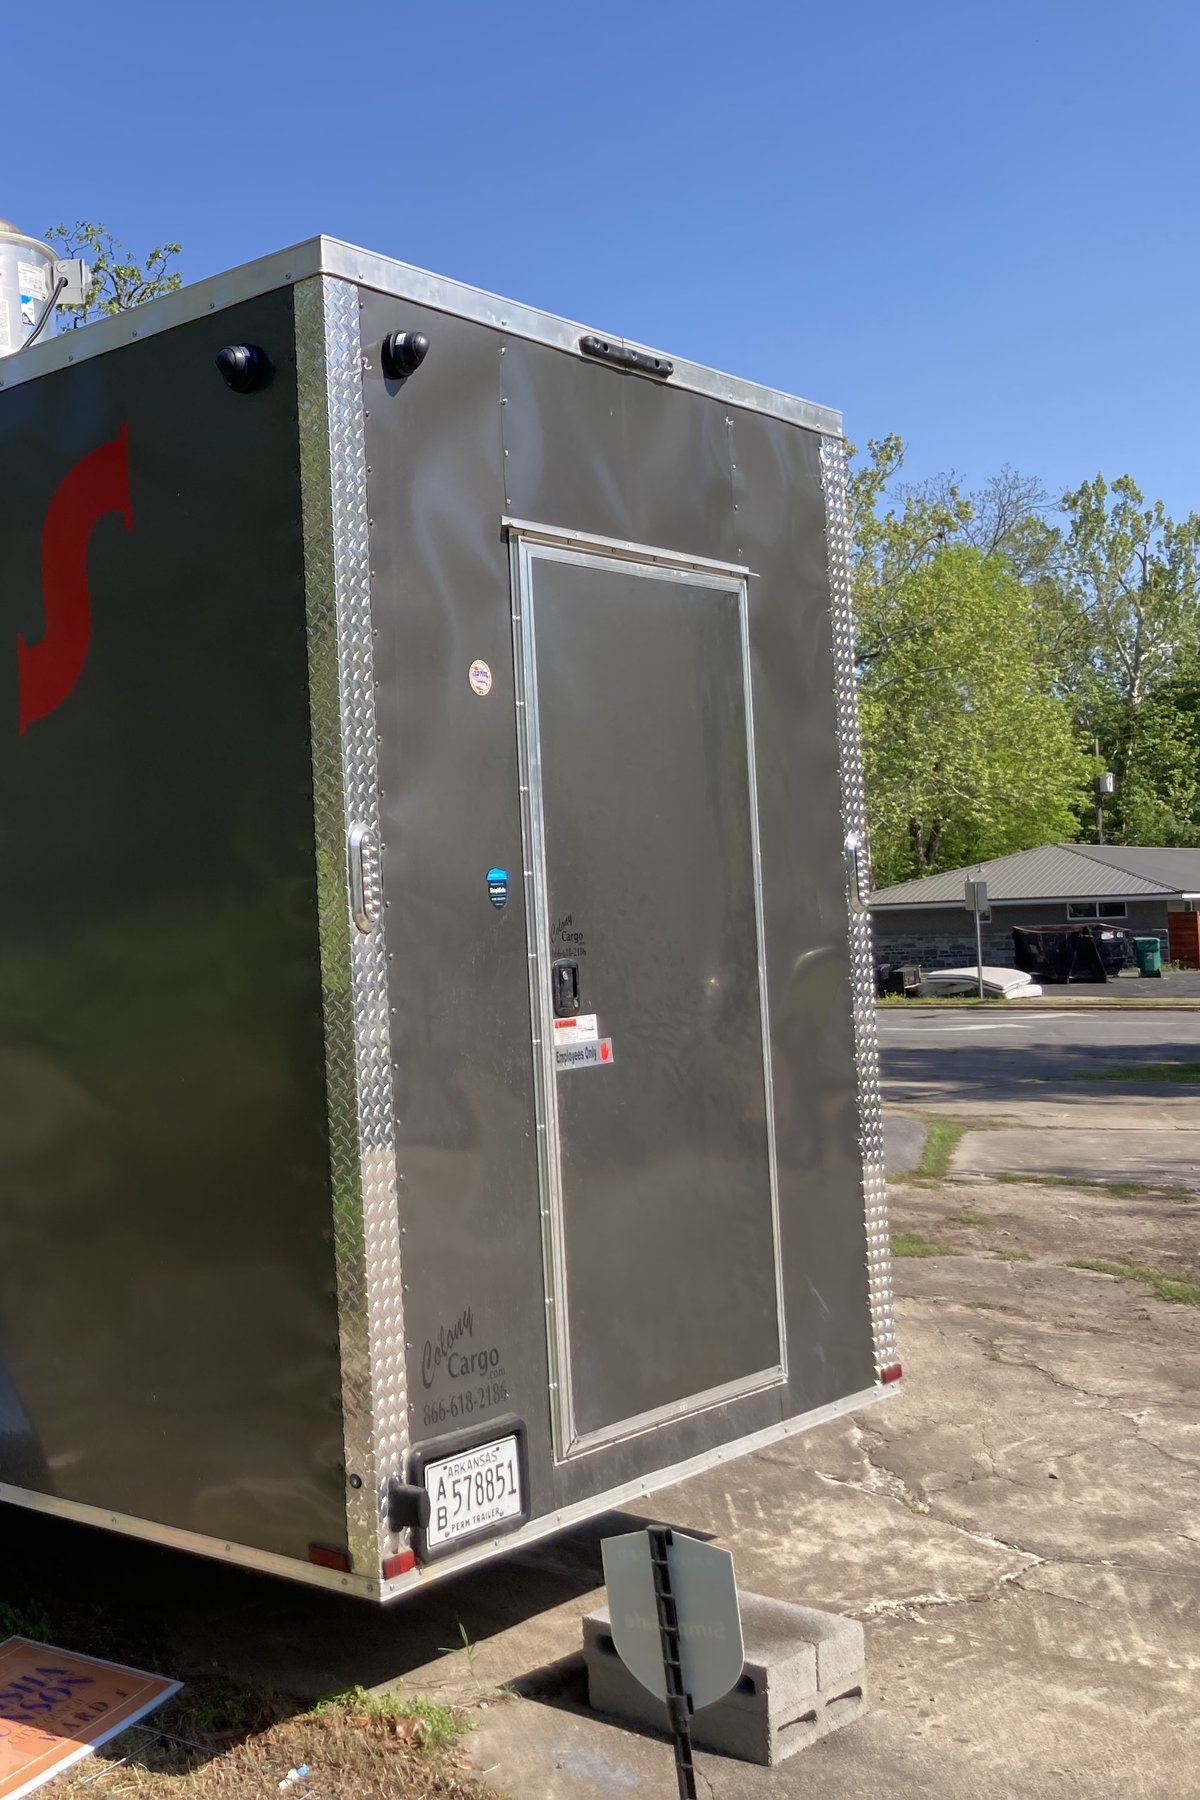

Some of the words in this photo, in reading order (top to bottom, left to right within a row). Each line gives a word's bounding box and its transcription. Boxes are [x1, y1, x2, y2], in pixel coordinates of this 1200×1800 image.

[561, 930, 583, 944] Cargo
[556, 1049, 584, 1066] Employees
[584, 1046, 597, 1061] Only
[422, 1306, 473, 1389] Colony
[448, 1348, 499, 1378] Cargo
[447, 1450, 498, 1478] ARKANSAS
[452, 1459, 517, 1517] 578851
[451, 1520, 471, 1533] PERM
[472, 1507, 500, 1525] TRAILER
[38, 1701, 109, 1741] WARD
